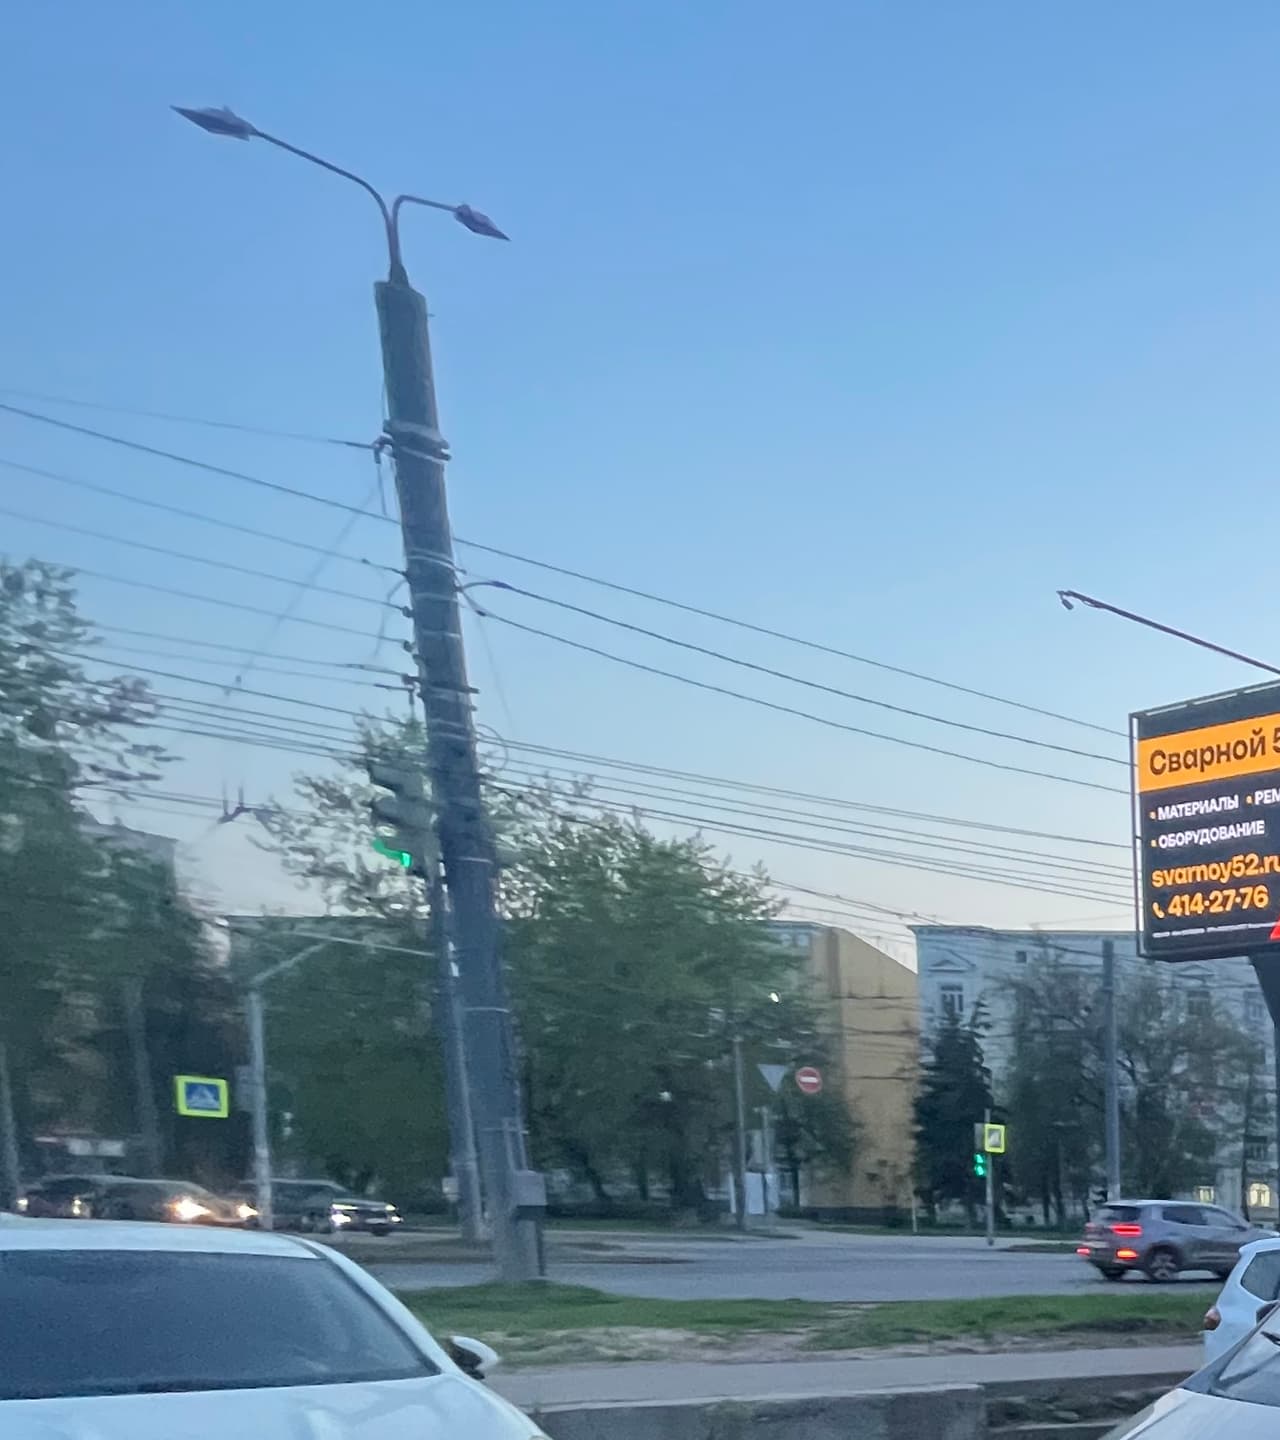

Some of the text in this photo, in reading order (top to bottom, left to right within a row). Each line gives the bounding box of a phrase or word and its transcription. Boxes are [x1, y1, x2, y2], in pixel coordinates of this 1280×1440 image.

[1150, 729, 1267, 776] Сварной
[1157, 794, 1239, 821] МАТЕРИАЛЫ
[1158, 819, 1265, 850] ОБОРУДОВАНИЕ
